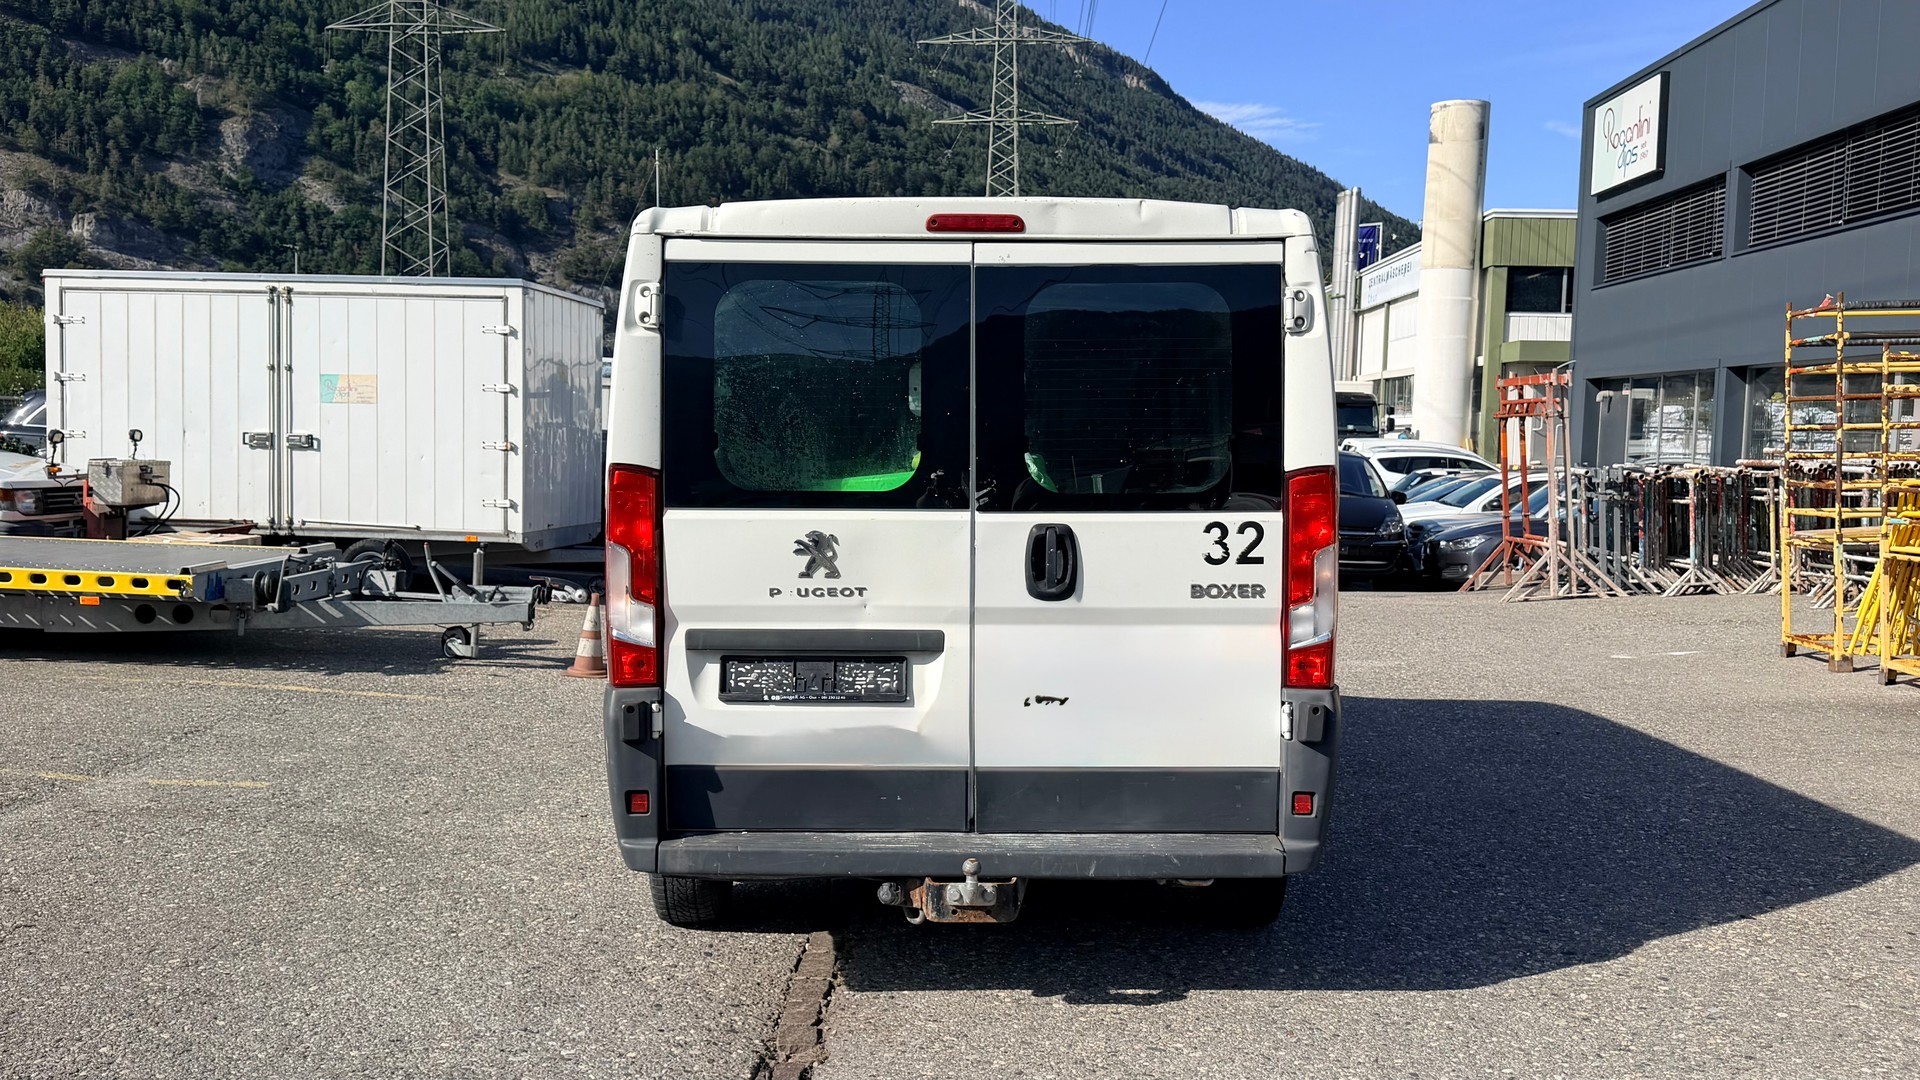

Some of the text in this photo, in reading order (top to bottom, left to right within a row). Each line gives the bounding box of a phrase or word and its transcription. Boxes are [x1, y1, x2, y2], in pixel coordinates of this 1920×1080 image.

[1203, 521, 1265, 565] 32
[769, 587, 868, 598] PUGEOT
[1190, 583, 1267, 599] BOXER
